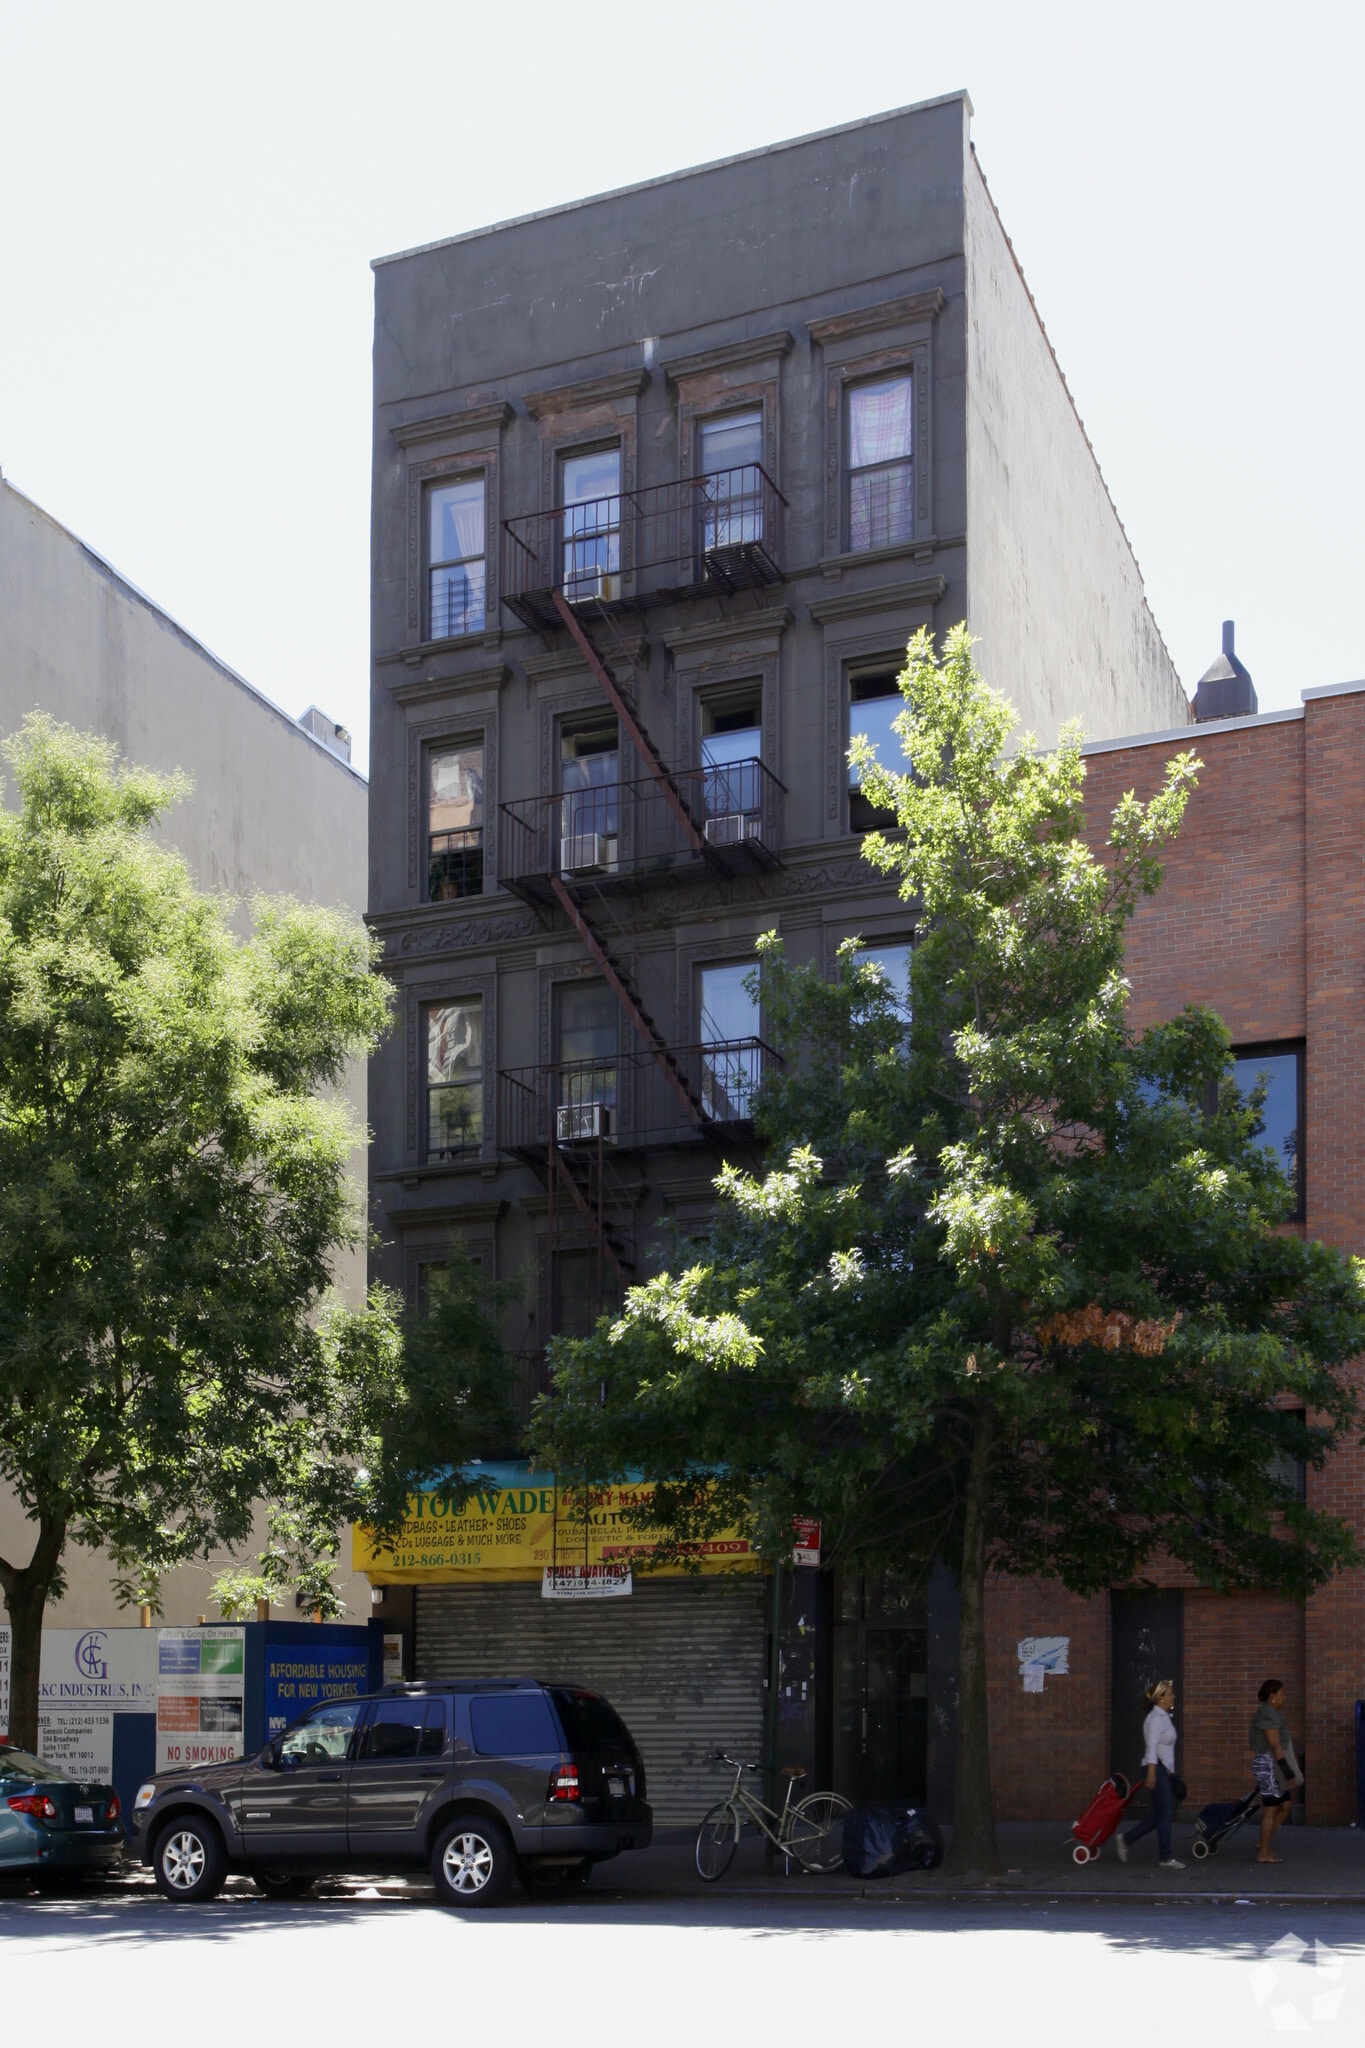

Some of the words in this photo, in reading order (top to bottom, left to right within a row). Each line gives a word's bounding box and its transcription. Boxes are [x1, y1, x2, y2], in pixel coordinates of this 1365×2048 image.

[474, 1490, 556, 1516] WADE
[445, 1519, 489, 1534] LEATHER
[496, 1517, 527, 1531] SHOES
[415, 1534, 456, 1549] LUGGAGE
[457, 1533, 465, 1546] &
[467, 1532, 493, 1546] MUCH
[496, 1532, 522, 1545] MORE
[637, 1532, 676, 1541] FOREIG
[392, 1551, 482, 1568] 212-866-0315
[546, 1566, 577, 1579] SPACE
[187, 1630, 206, 1639] Going
[207, 1630, 217, 1638] On
[218, 1629, 238, 1638] Here?
[269, 1663, 325, 1678] AFFORDABLE
[328, 1663, 367, 1678] HOUSING
[38, 1684, 57, 1697] KC
[60, 1684, 129, 1699] INDUSTRIES,
[278, 1683, 296, 1698] FOR
[299, 1683, 318, 1697] NEW
[321, 1683, 358, 1697] YORKERS
[57, 1717, 68, 1725] TEL:
[69, 1717, 83, 1726] (212)
[84, 1717, 94, 1725] 433
[96, 1717, 109, 1725] 1336
[43, 1727, 62, 1735] Genesis
[64, 1727, 93, 1736] Companies
[43, 1735, 53, 1743] 594
[54, 1736, 79, 1744] Broadway
[57, 1743, 70, 1751] 1107
[167, 1745, 181, 1761] NO
[185, 1745, 235, 1761] SMOKING
[70, 1751, 77, 1759] NY
[78, 1751, 94, 1759] 10012
[69, 1766, 79, 1774] TEL:
